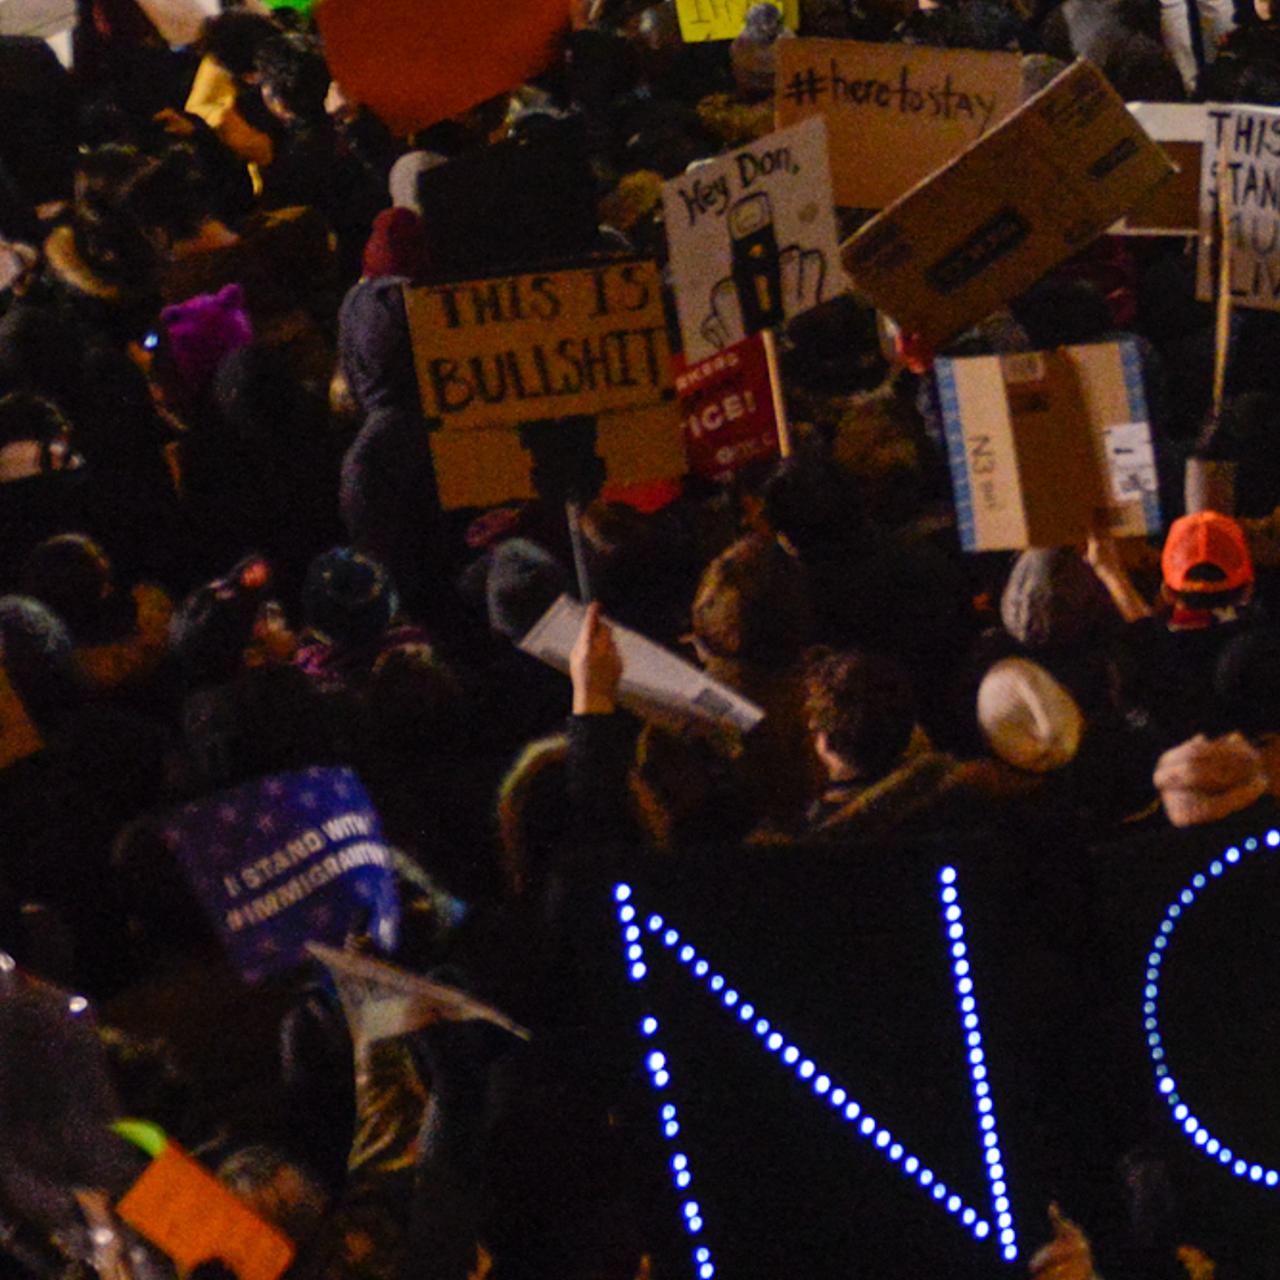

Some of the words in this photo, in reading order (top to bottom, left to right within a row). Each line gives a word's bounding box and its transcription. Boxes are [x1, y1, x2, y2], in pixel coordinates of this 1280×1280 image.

[677, 177, 731, 227] Hey
[737, 145, 801, 190] Don,
[438, 277, 562, 329] THIS
[588, 262, 650, 318] IS
[685, 388, 758, 438] ICE!
[240, 830, 327, 890] STAND
